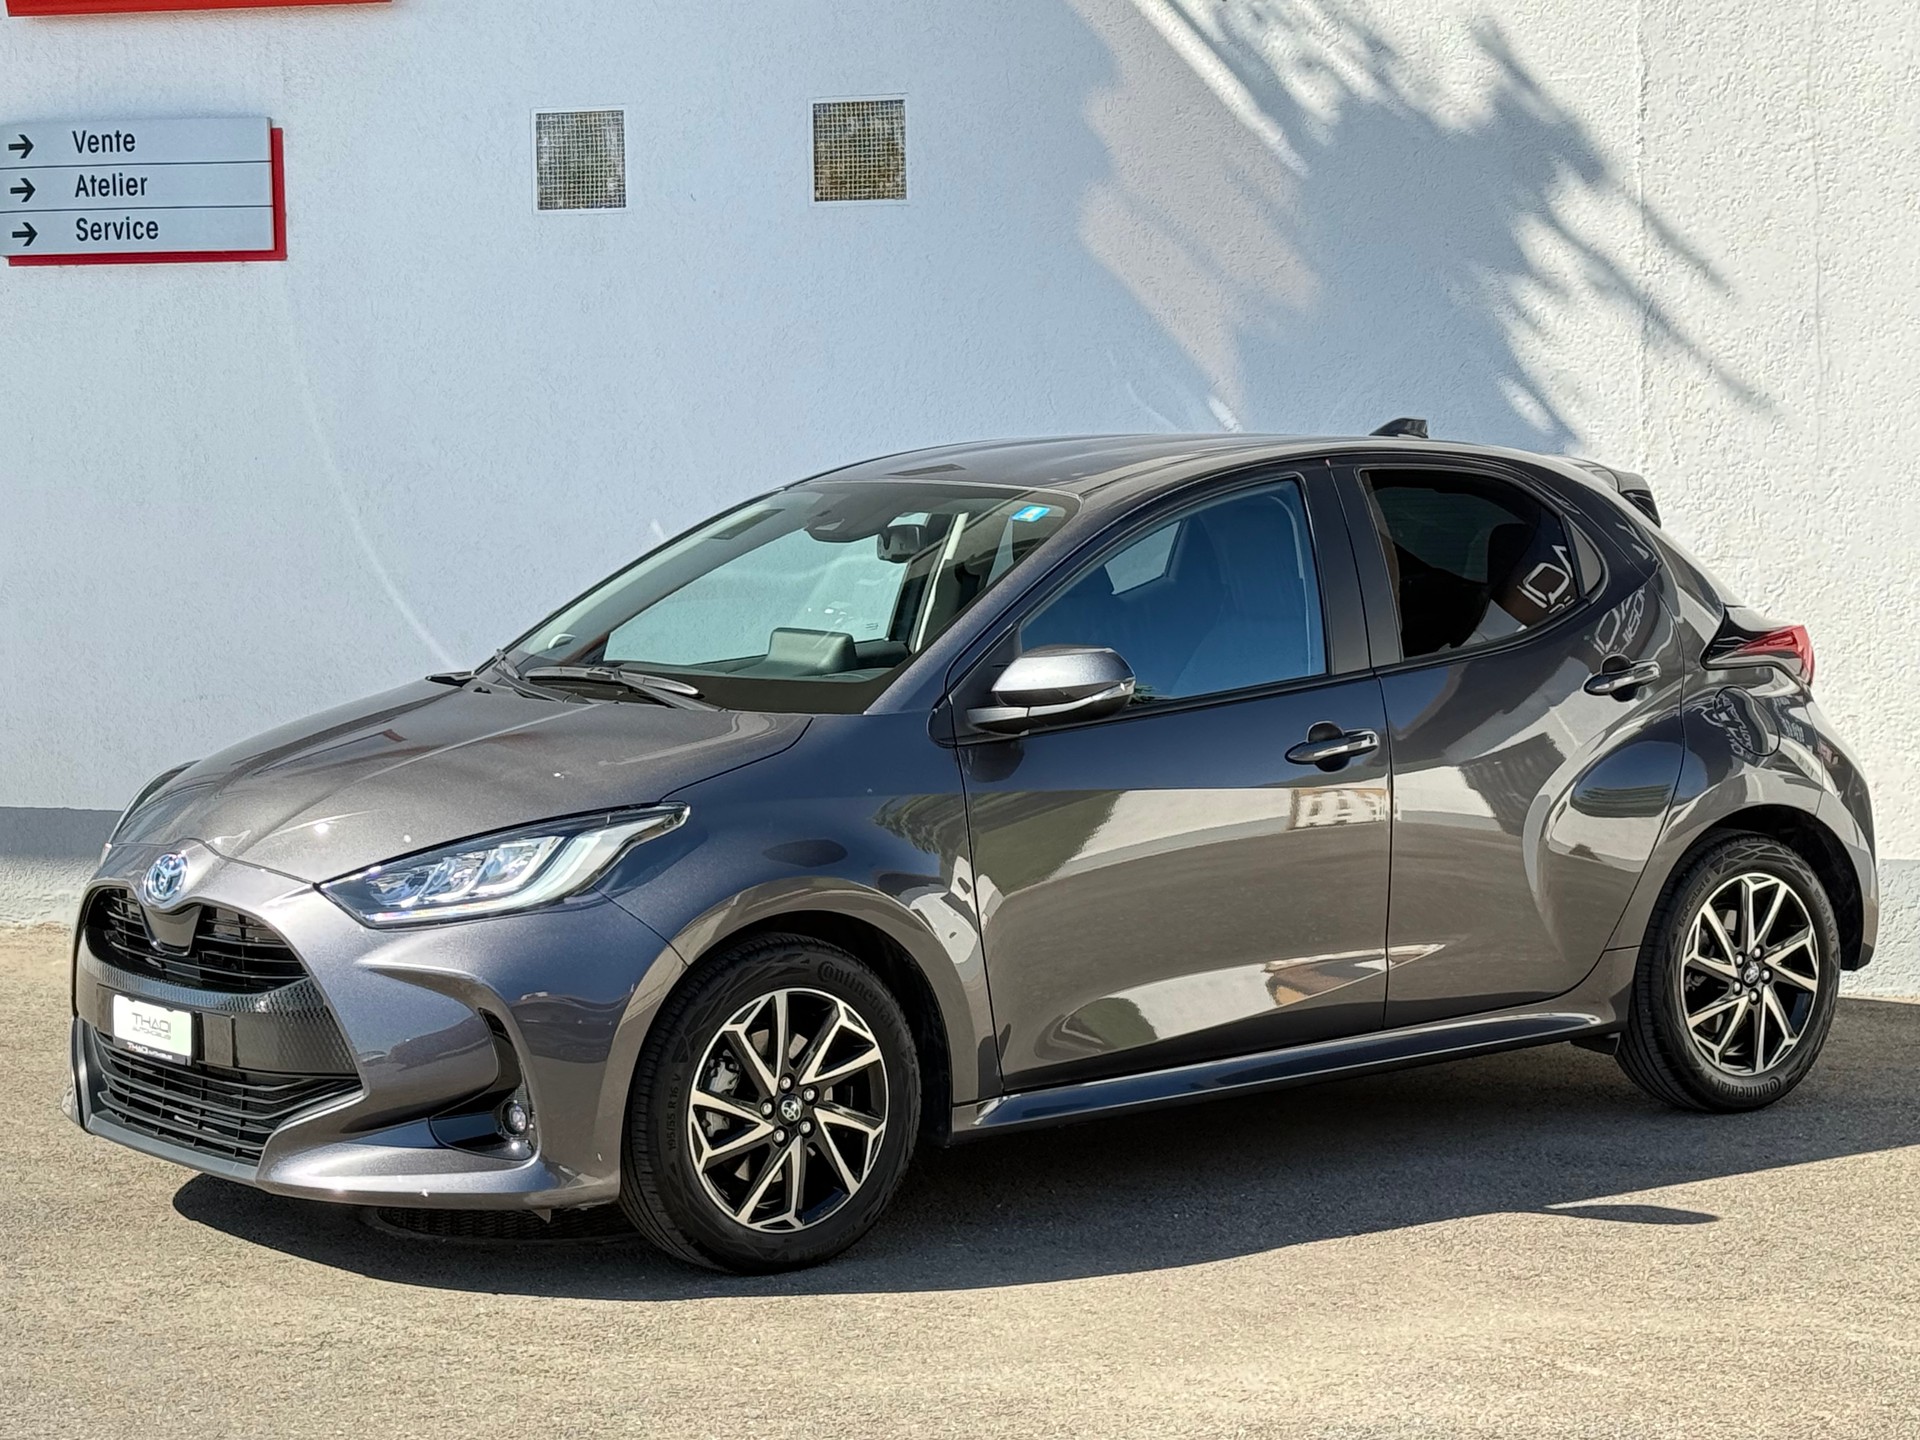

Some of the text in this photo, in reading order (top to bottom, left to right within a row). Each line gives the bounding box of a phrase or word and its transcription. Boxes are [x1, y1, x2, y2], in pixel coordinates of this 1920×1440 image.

[72, 130, 136, 153] Vente
[75, 172, 148, 198] Atelier
[75, 216, 159, 241] Service
[818, 961, 896, 1028] Continental
[670, 1086, 680, 1099] 16
[1717, 1076, 1781, 1097] Continental
[666, 1113, 677, 1151] 195/55
